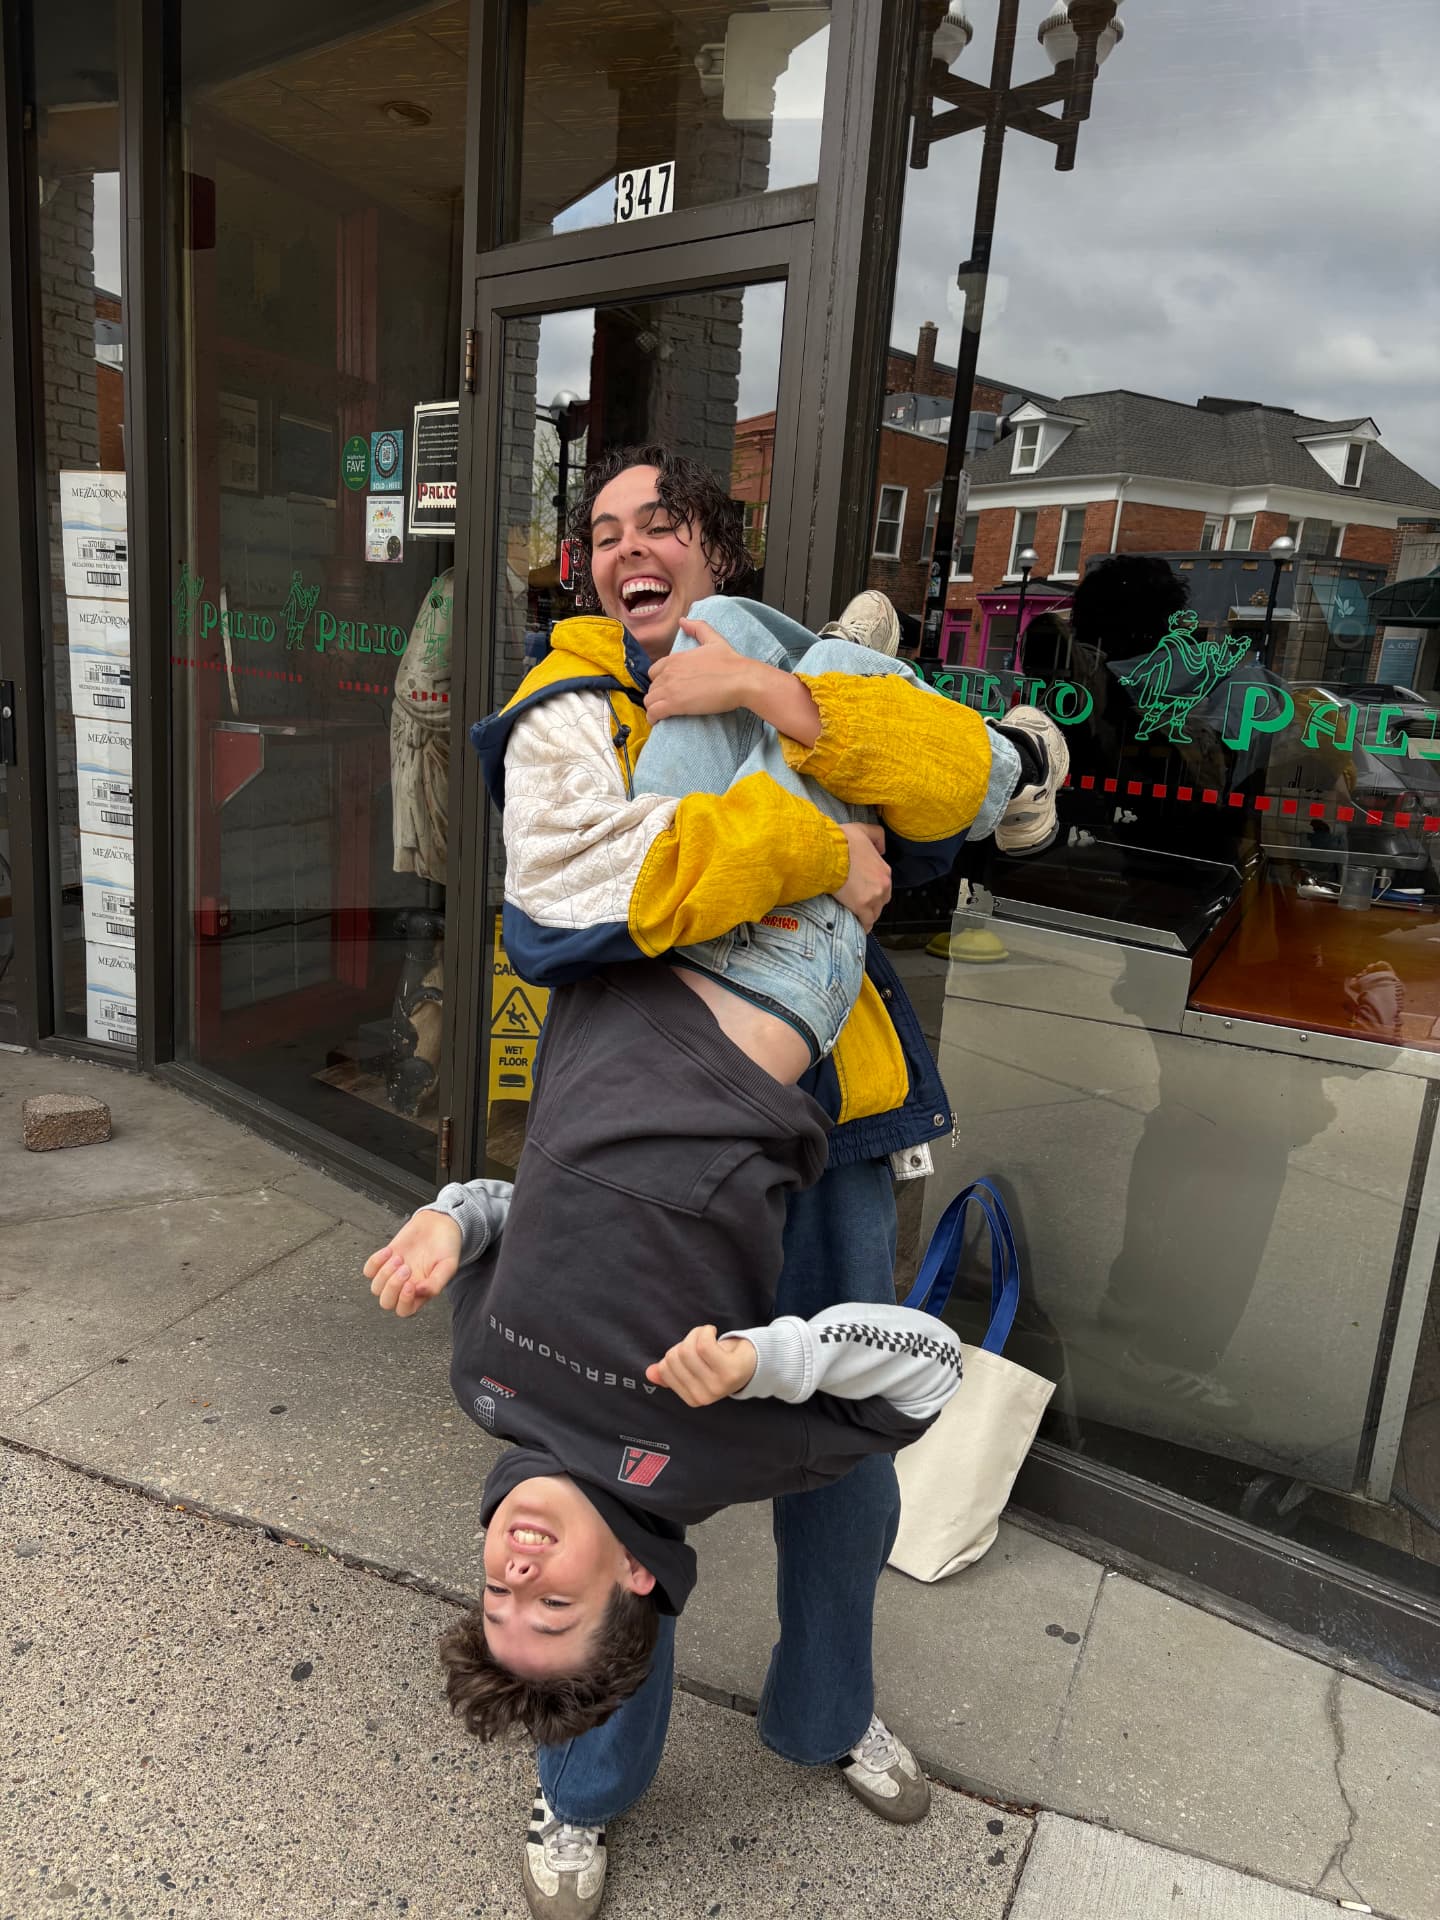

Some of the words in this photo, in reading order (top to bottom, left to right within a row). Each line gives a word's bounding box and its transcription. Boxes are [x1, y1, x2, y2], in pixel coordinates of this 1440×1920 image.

[620, 164, 671, 220] 347
[346, 460, 366, 472] FAVE
[200, 600, 277, 643] PALIO
[313, 610, 409, 657] PALIO
[896, 657, 1094, 725] ALIO
[494, 962, 517, 976] CAU
[498, 1056, 528, 1067] FLOOR
[505, 1045, 524, 1055] WET
[489, 1315, 657, 1395] ABERCROMBIE
